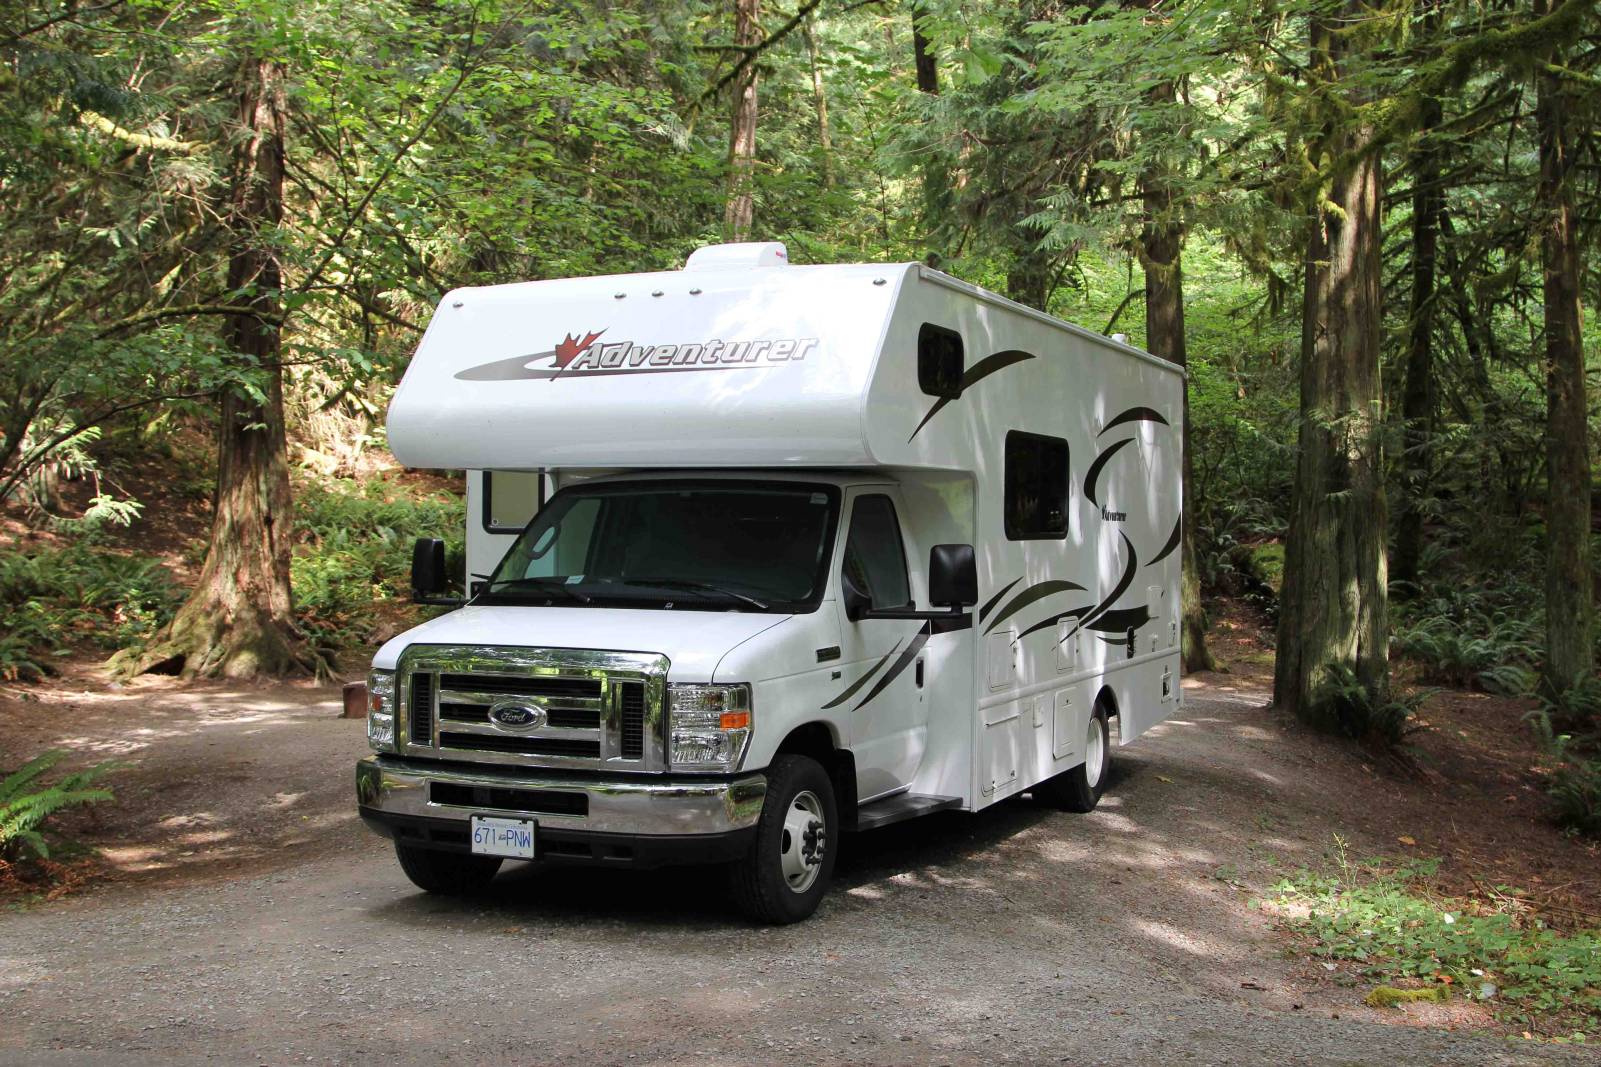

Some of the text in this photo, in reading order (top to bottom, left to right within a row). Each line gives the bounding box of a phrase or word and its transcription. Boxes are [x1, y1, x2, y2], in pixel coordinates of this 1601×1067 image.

[572, 337, 820, 369] Adventurer
[500, 711, 526, 721] Ford
[474, 826, 531, 848] 671 PNW
